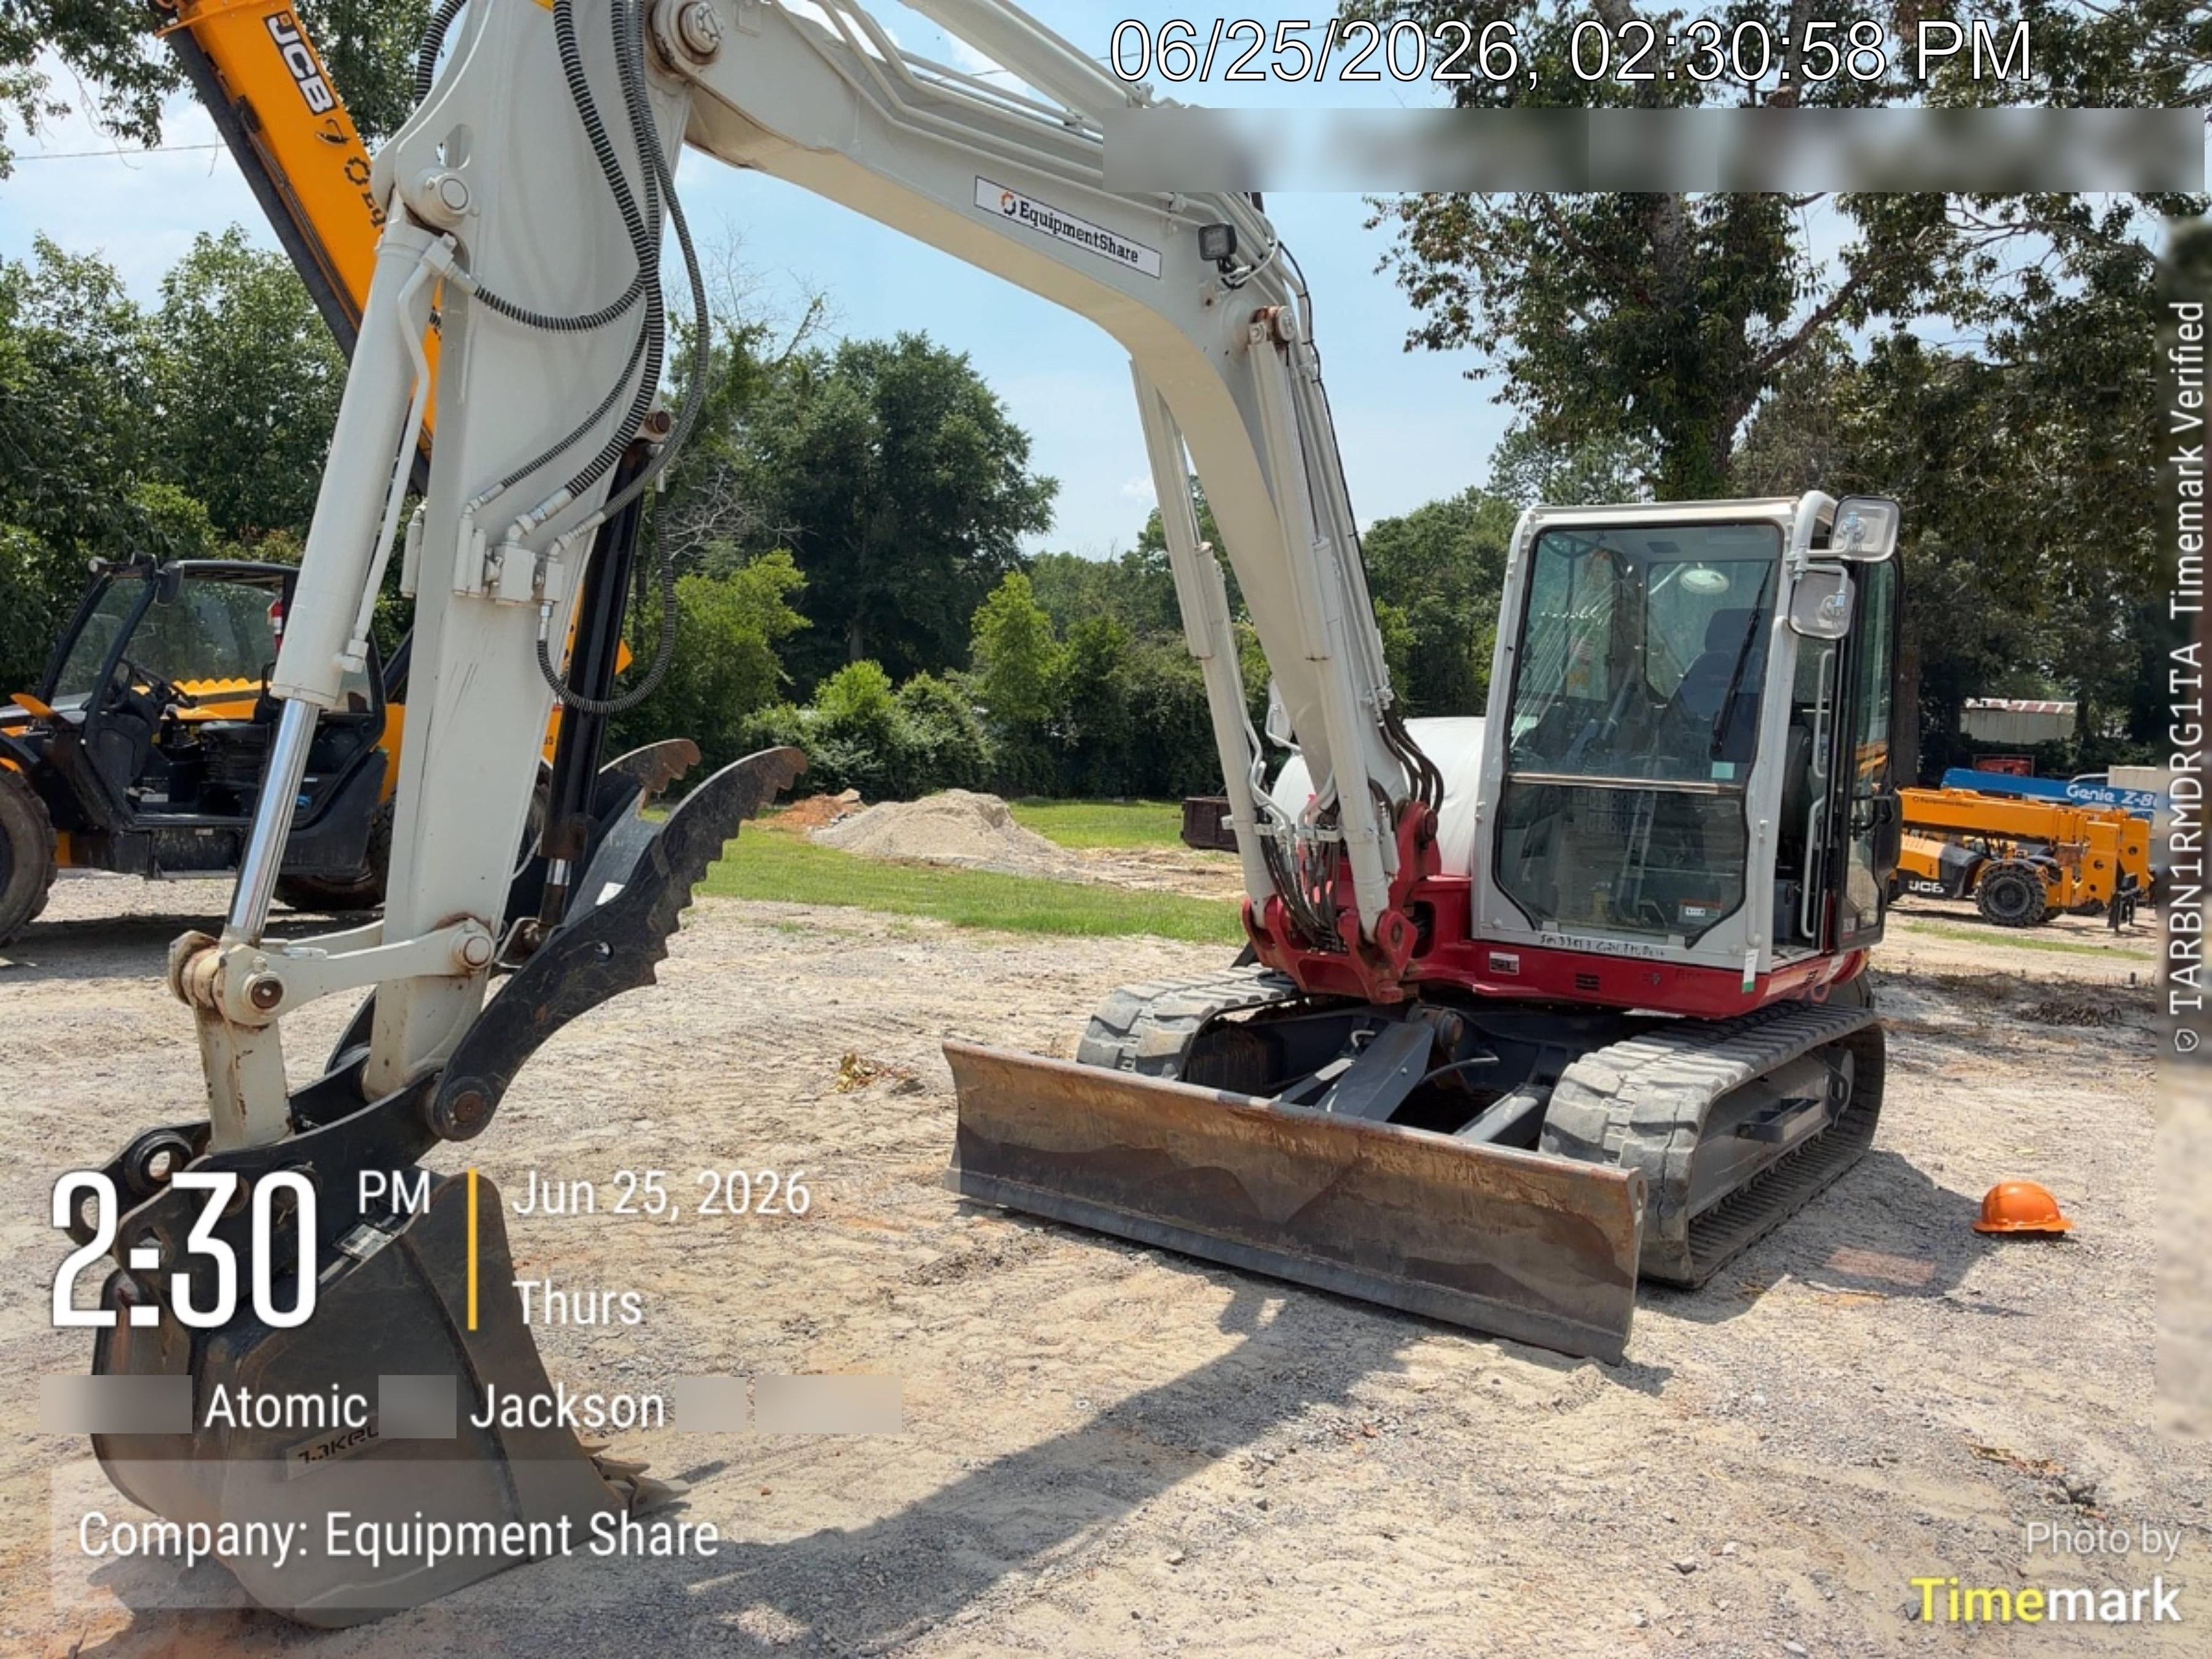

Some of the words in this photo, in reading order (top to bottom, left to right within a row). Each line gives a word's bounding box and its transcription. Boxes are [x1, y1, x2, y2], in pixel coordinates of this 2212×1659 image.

[268, 15, 336, 115] JCB
[1019, 200, 1139, 264] EquipmentShare
[2066, 784, 2115, 802] Genie
